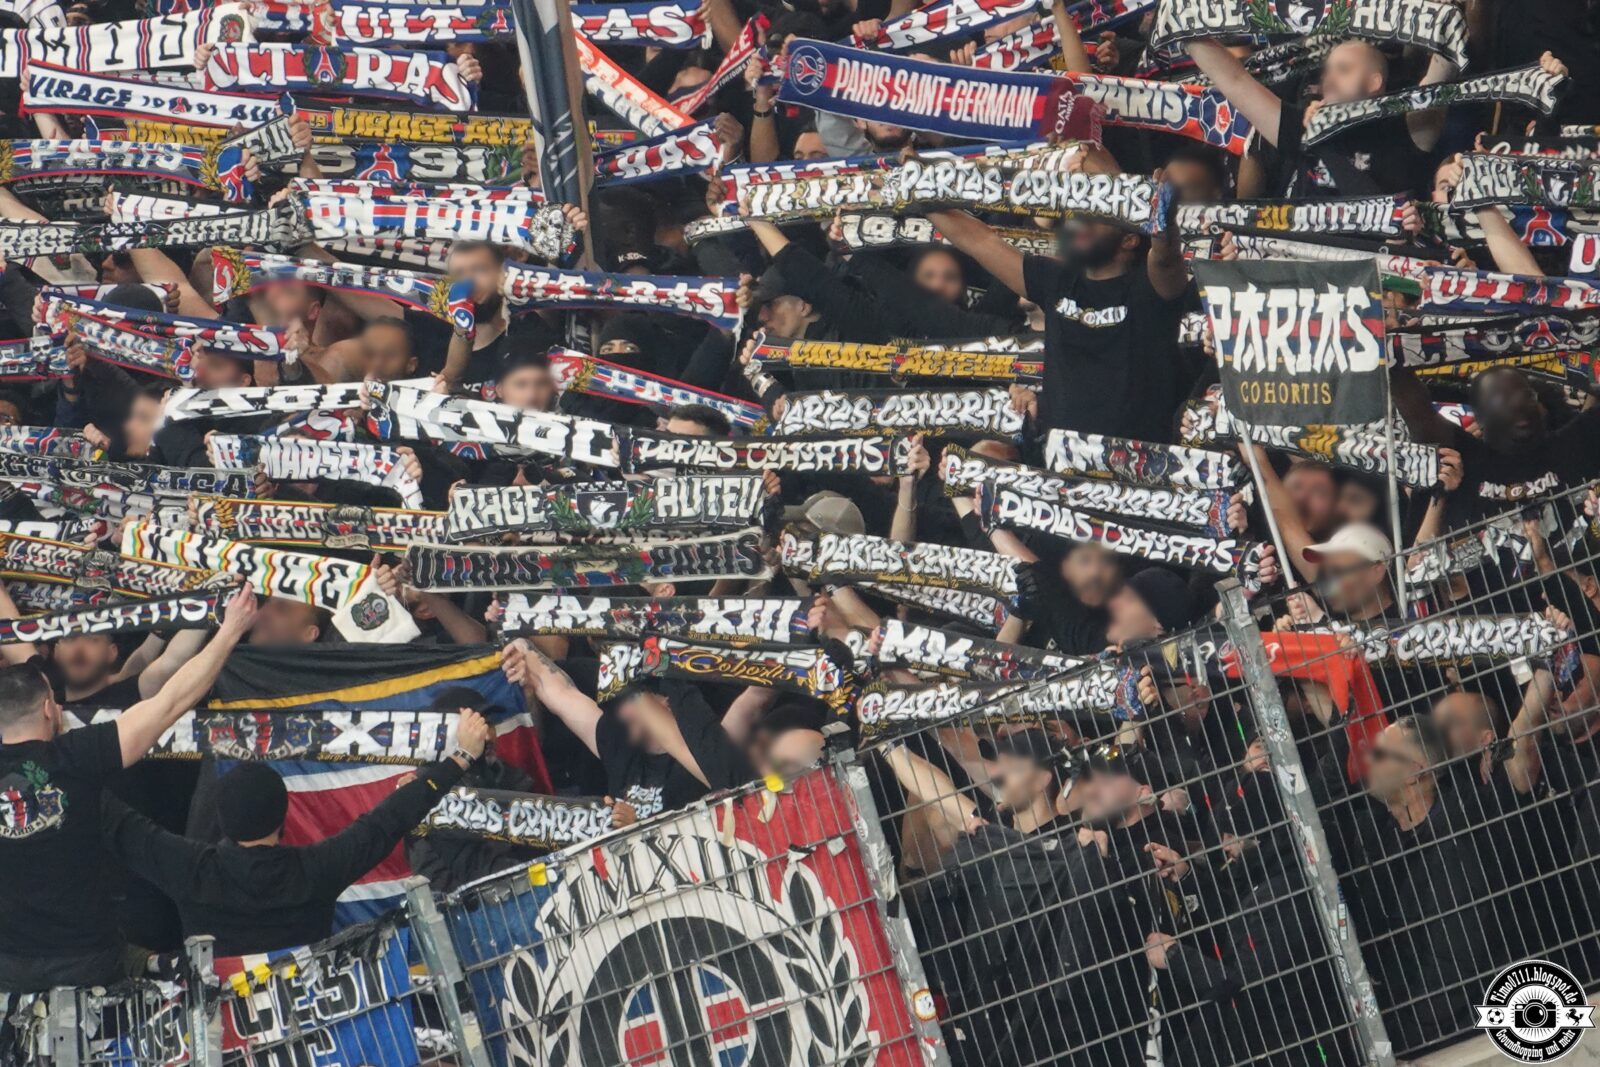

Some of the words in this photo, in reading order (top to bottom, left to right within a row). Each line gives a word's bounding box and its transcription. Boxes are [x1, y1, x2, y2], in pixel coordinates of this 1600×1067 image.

[27, 72, 133, 108] VIRAGE
[352, 48, 472, 111] RAS
[831, 57, 886, 108] PARIS
[887, 69, 1040, 128] SAINT-GERMAIN
[1080, 75, 1190, 124] PARIS
[1054, 91, 1073, 134] QATA
[897, 160, 1003, 204] PARIAS
[1009, 168, 1154, 223] COHORTIS
[165, 212, 272, 246] AUTEUI
[1204, 282, 1382, 376] PARIAS
[788, 340, 897, 370] VIRAGE
[902, 349, 1019, 379] AUTEUIL
[876, 391, 1026, 433] COHORTIS
[1240, 380, 1333, 406] COHORTIS
[637, 437, 739, 471] PARIAS
[746, 436, 887, 473] COHORTIS
[654, 476, 765, 521] AUTEU
[999, 489, 1093, 542] PARIAS
[1101, 520, 1237, 574] COHORTIS
[12, 598, 208, 642] COHORTIS
[678, 648, 797, 686] Cohortis
[2, 824, 36, 837] PARIS
[423, 787, 503, 833] ARIAS
[508, 799, 614, 845] COHORTI
